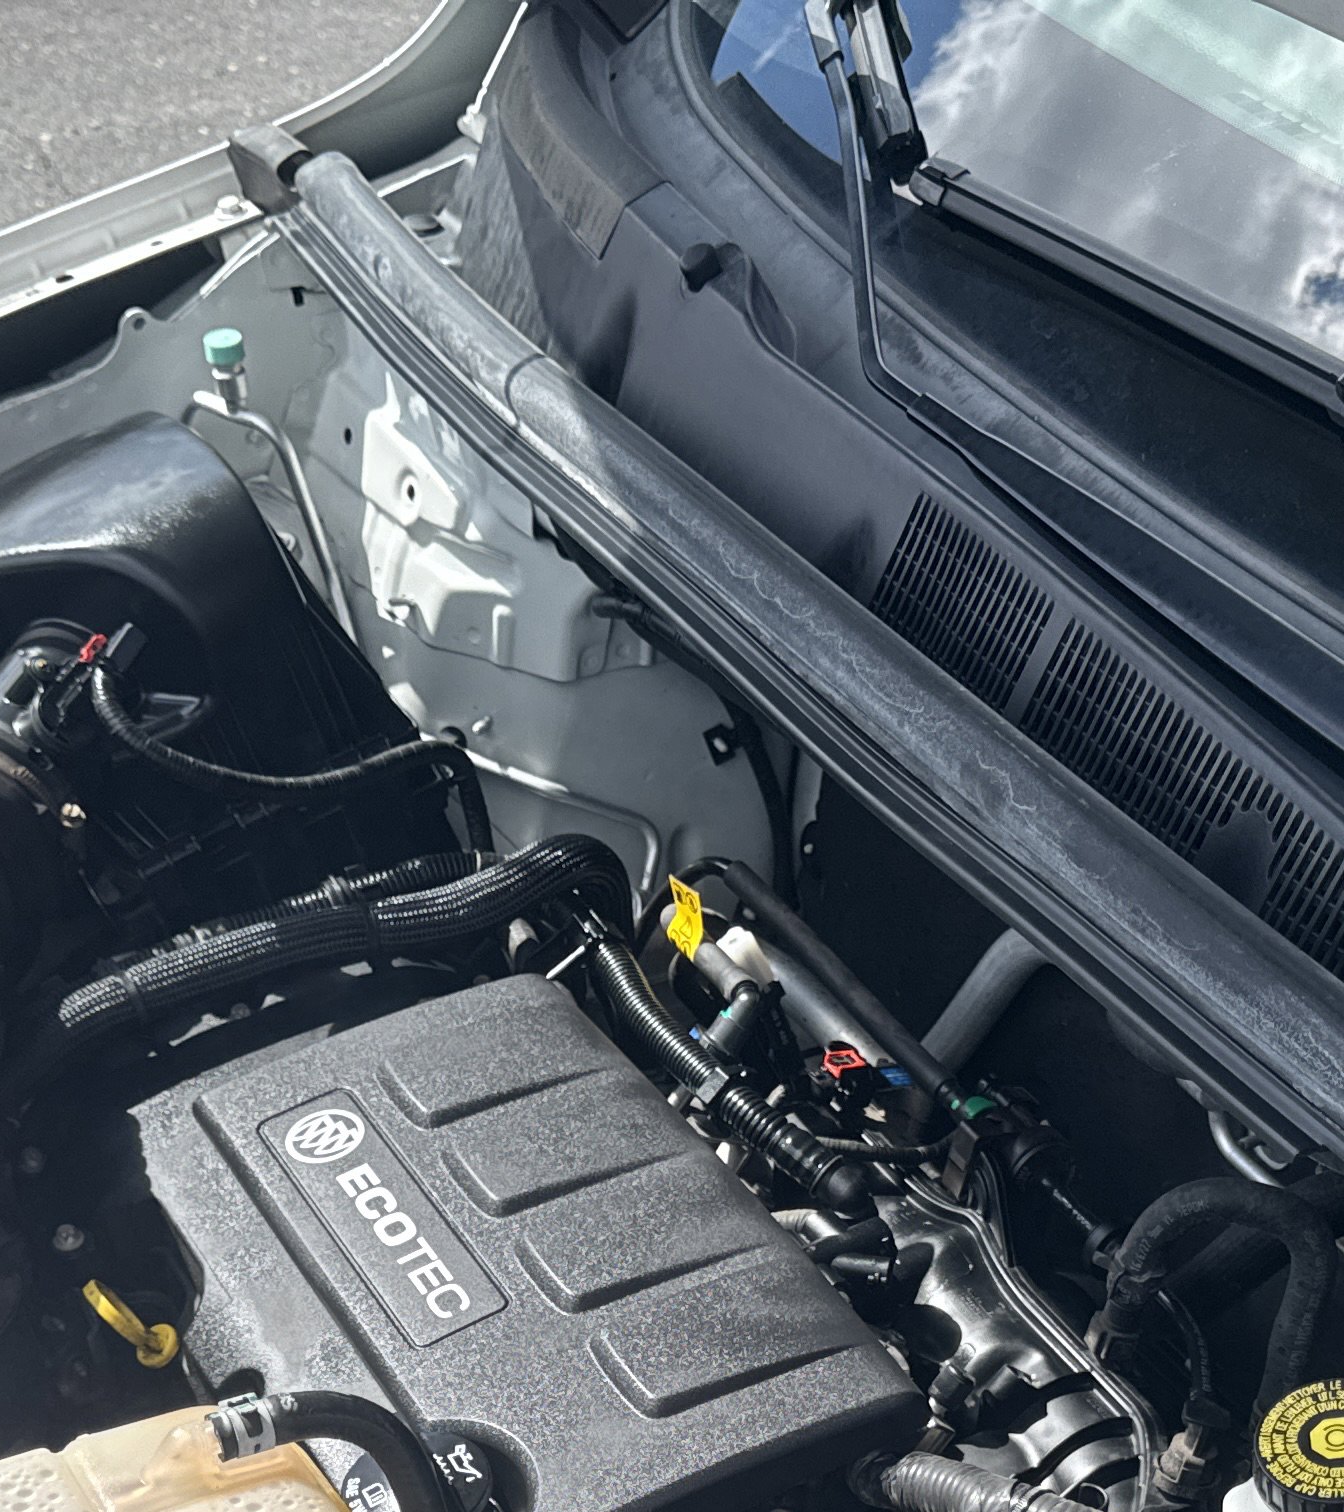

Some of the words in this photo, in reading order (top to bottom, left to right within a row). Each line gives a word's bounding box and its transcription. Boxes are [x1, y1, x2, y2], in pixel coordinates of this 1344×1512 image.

[337, 1164, 470, 1320] ECOTEC
[1330, 1380, 1341, 1390] LE
[345, 1477, 360, 1498] SAE
[1295, 1483, 1316, 1495] CAP
